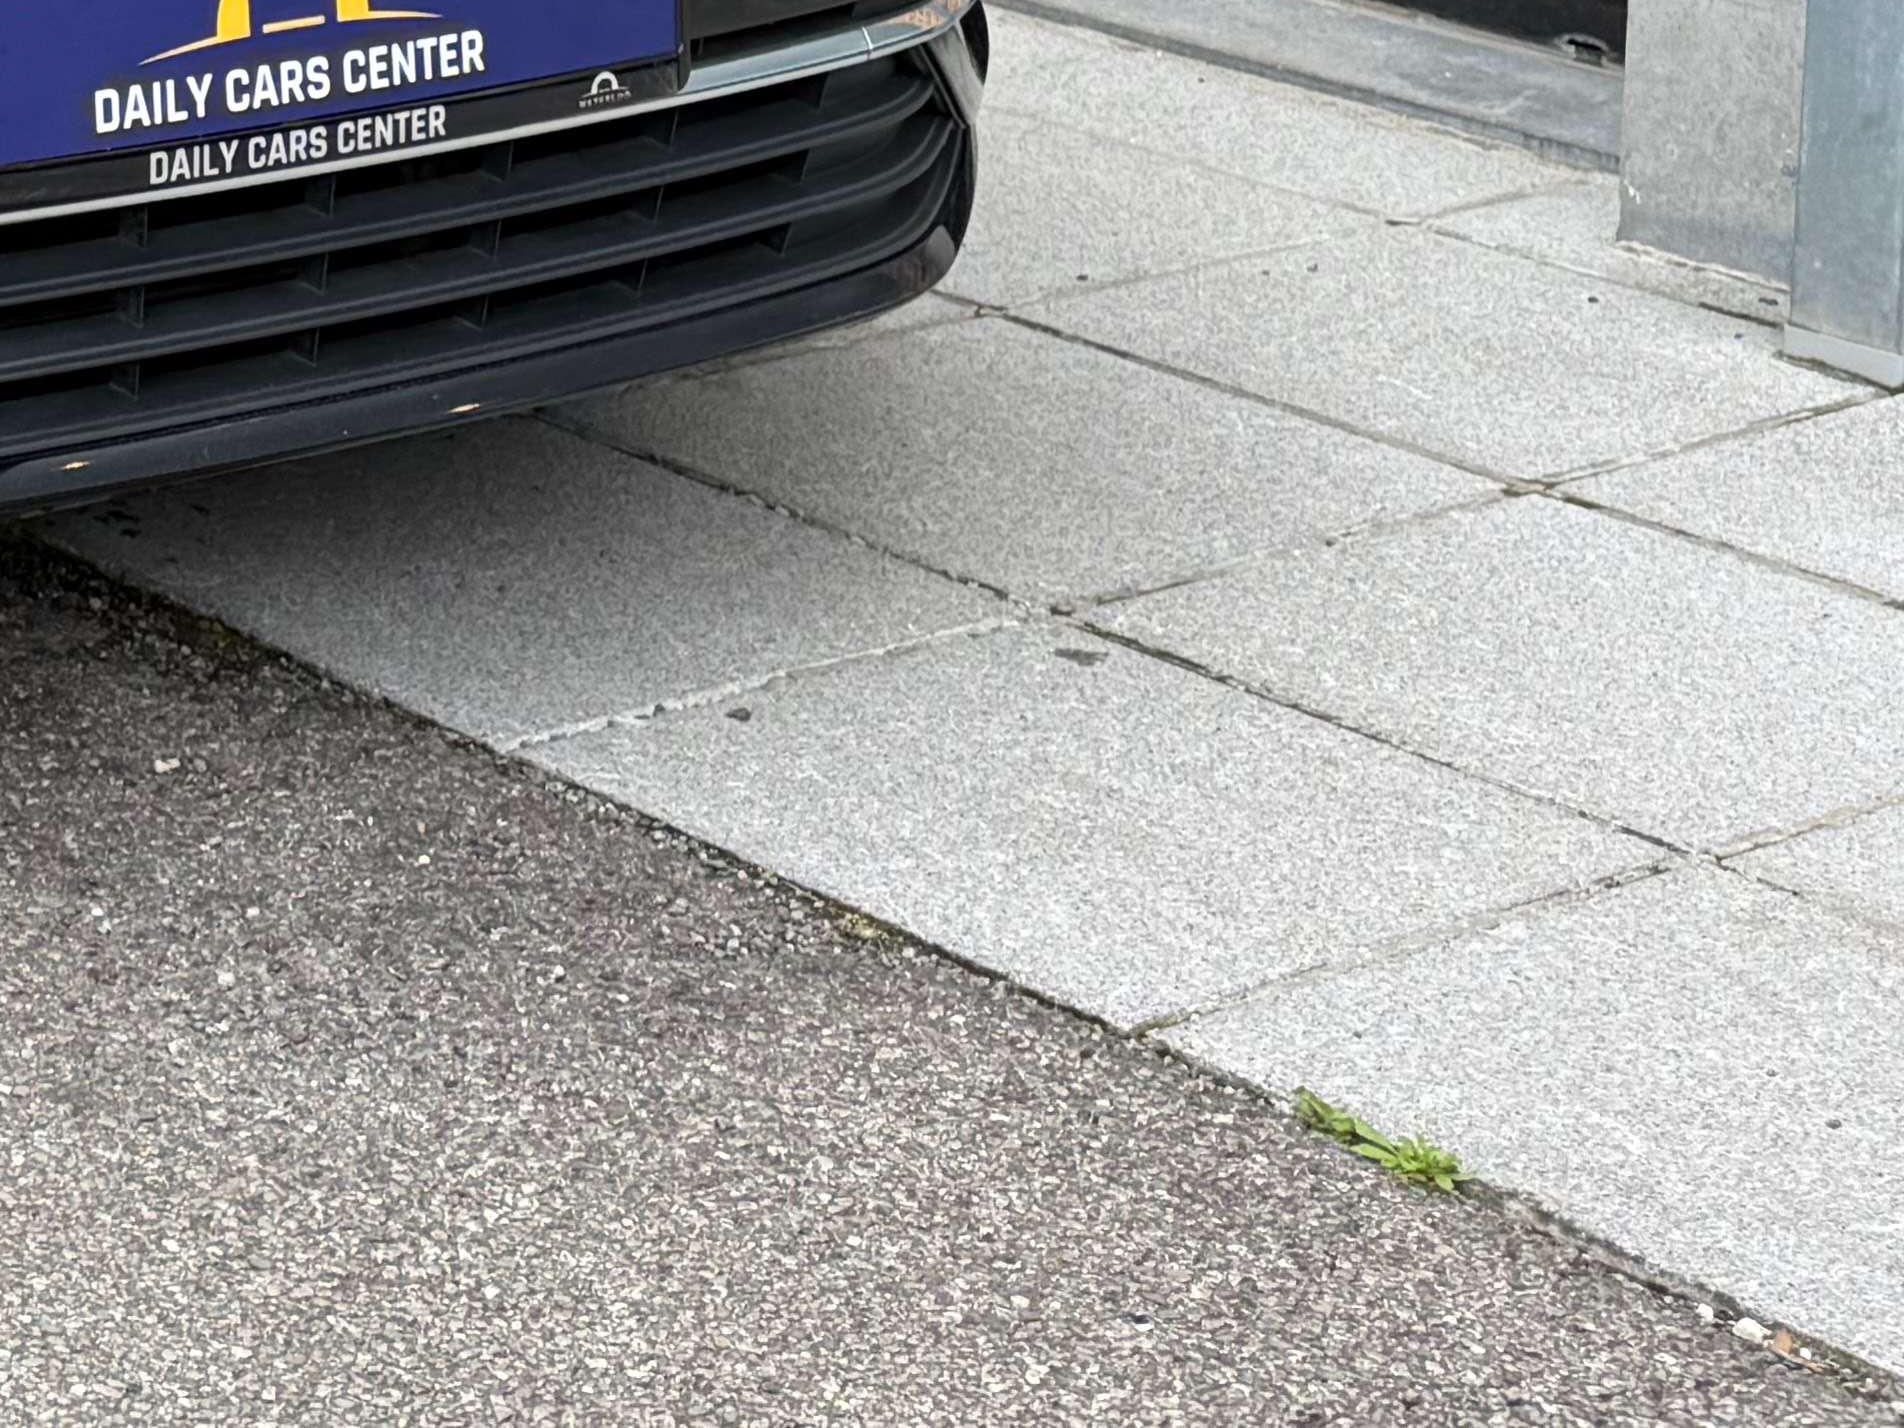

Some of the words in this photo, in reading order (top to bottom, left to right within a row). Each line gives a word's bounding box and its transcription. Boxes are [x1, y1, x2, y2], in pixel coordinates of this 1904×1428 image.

[94, 72, 213, 134] DAILY
[225, 56, 331, 112] CARS
[343, 29, 485, 93] CENTER
[149, 139, 238, 185] DAILY
[248, 125, 327, 169] CARS
[337, 104, 446, 155] CENTER
